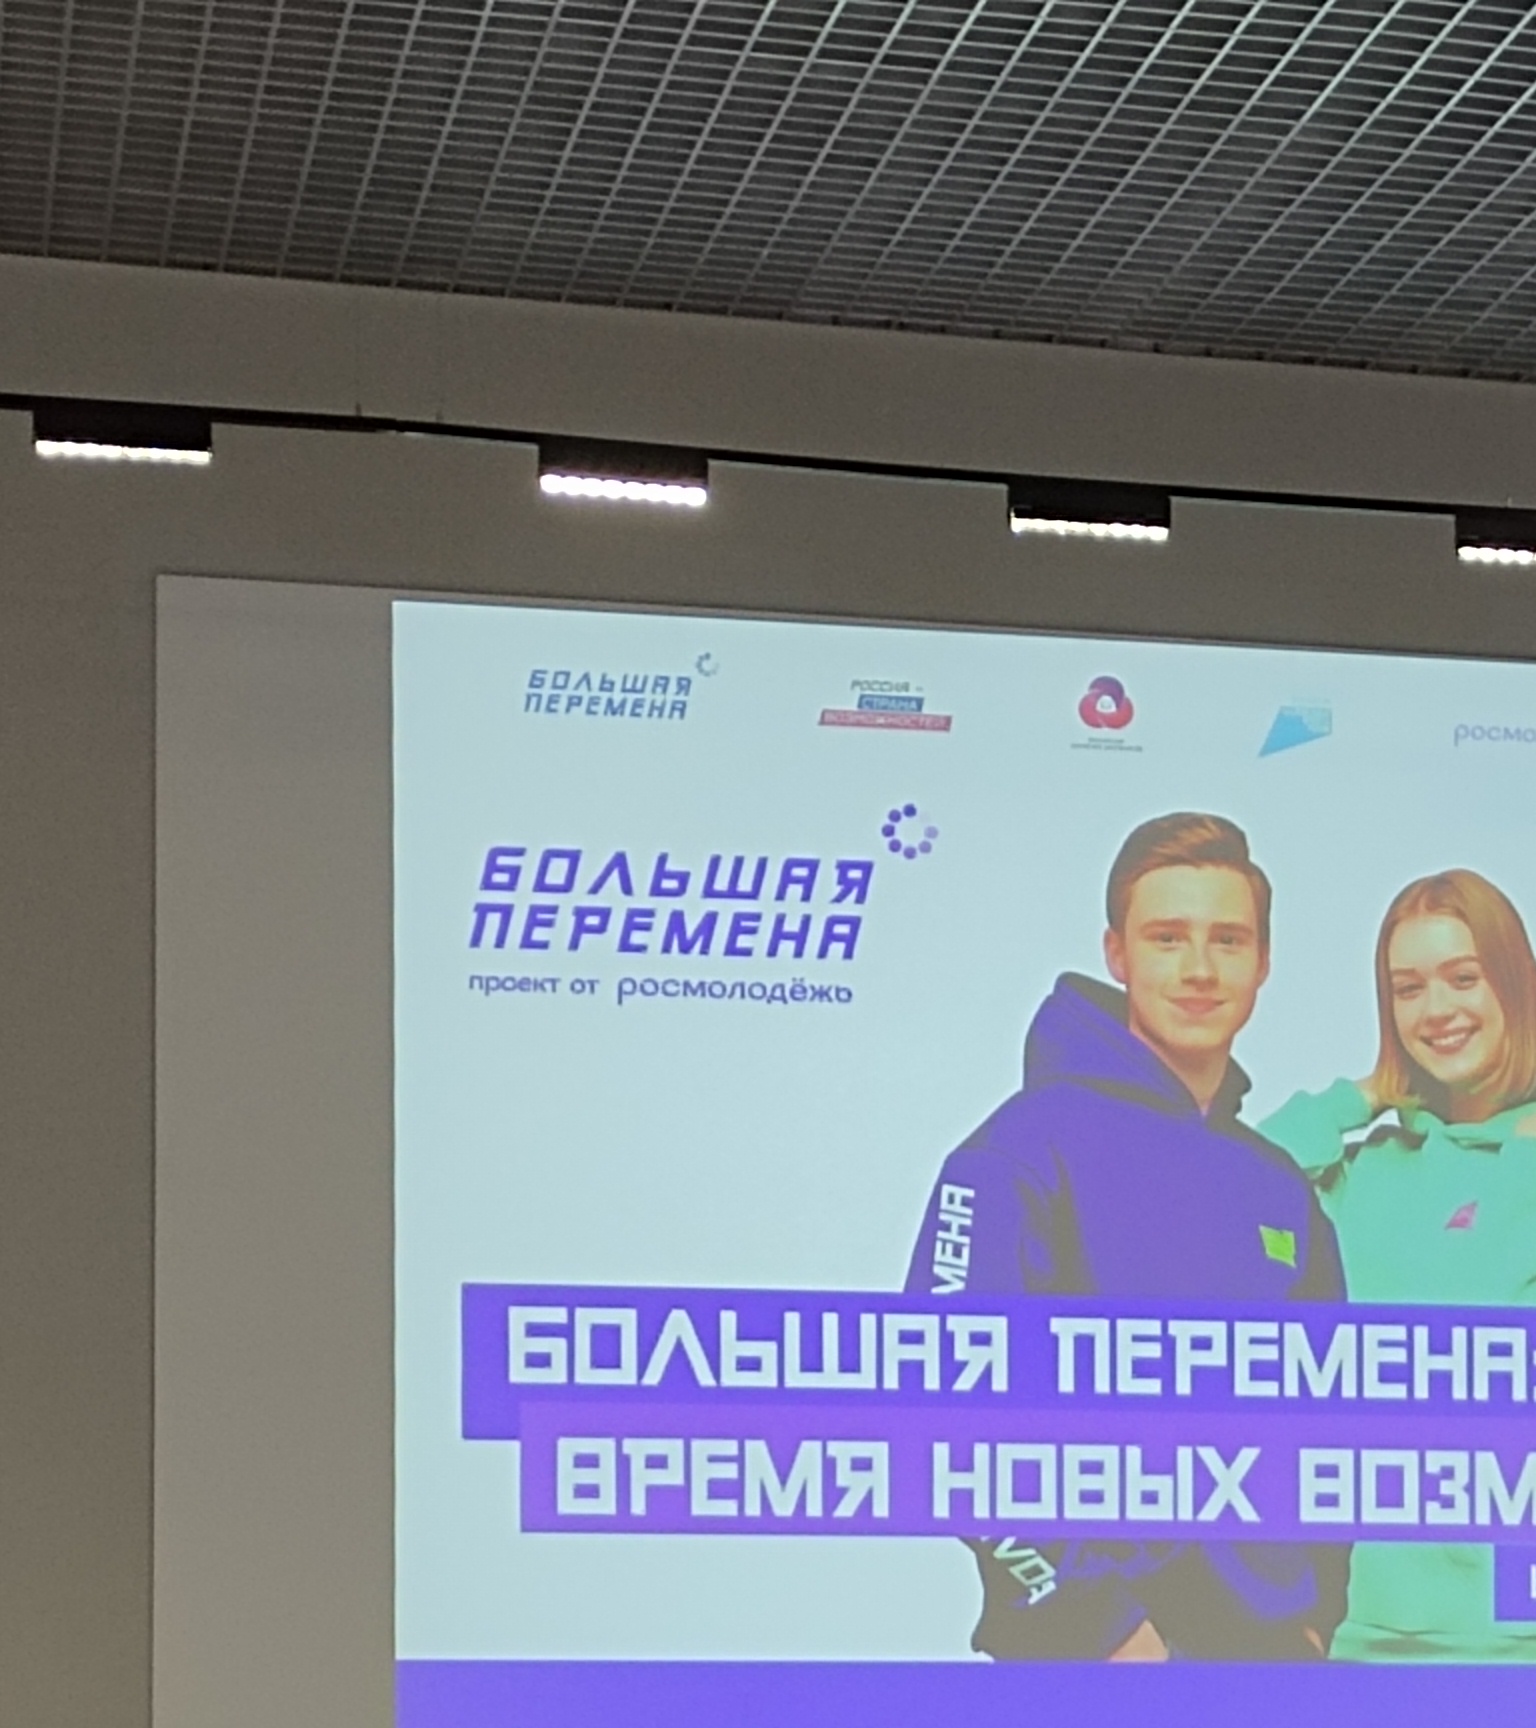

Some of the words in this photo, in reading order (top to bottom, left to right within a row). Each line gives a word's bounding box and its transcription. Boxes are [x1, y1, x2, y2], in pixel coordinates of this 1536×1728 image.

[524, 693, 688, 720] ПЕРЕМЕНА
[528, 669, 691, 696] БОЛЬШАЯ
[478, 845, 875, 905] БОЛЬШАЯ
[468, 902, 863, 961] ПЕРЕМЕНА
[468, 973, 562, 1001] проект
[570, 978, 599, 997] от
[616, 975, 853, 1007] росмолодёжь
[508, 1306, 1008, 1393] БОЛЬШАЯ
[556, 1437, 889, 1518] ВРЕМЯ
[932, 1442, 1262, 1524] НОВЫХ
